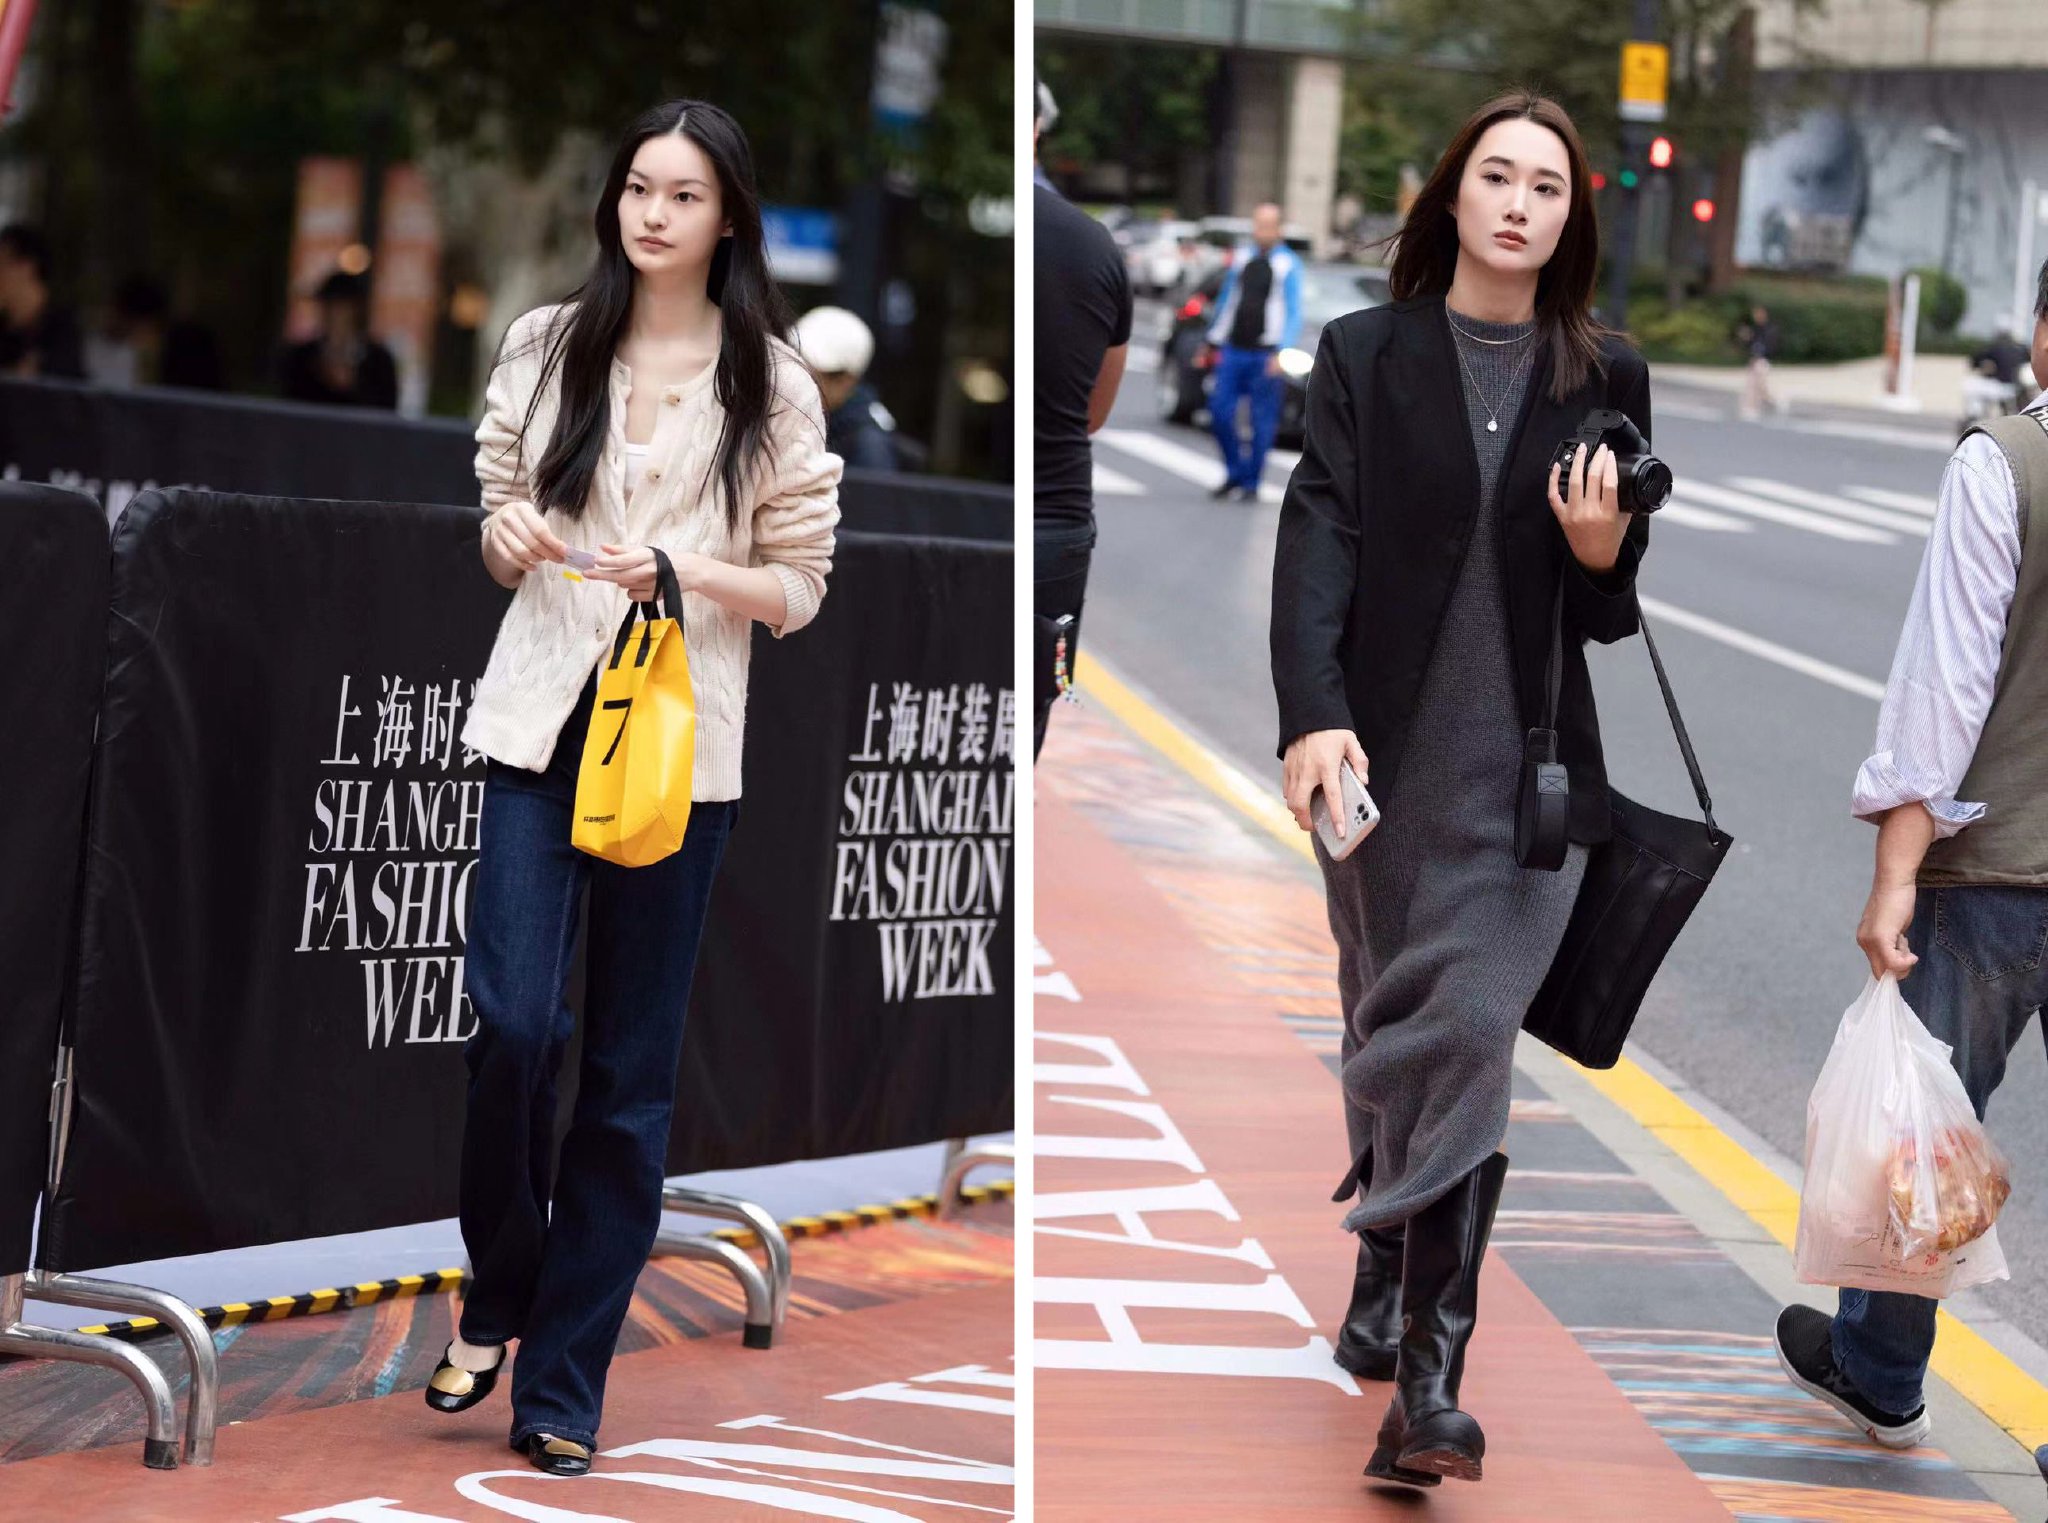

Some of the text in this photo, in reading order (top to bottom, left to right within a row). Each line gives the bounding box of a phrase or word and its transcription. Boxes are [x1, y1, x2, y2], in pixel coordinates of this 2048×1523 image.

[848, 681, 1014, 765] 上海时装周
[839, 769, 1014, 836] SHANGHAI
[829, 836, 1011, 920] FASHION
[877, 918, 998, 1003] WEEK
